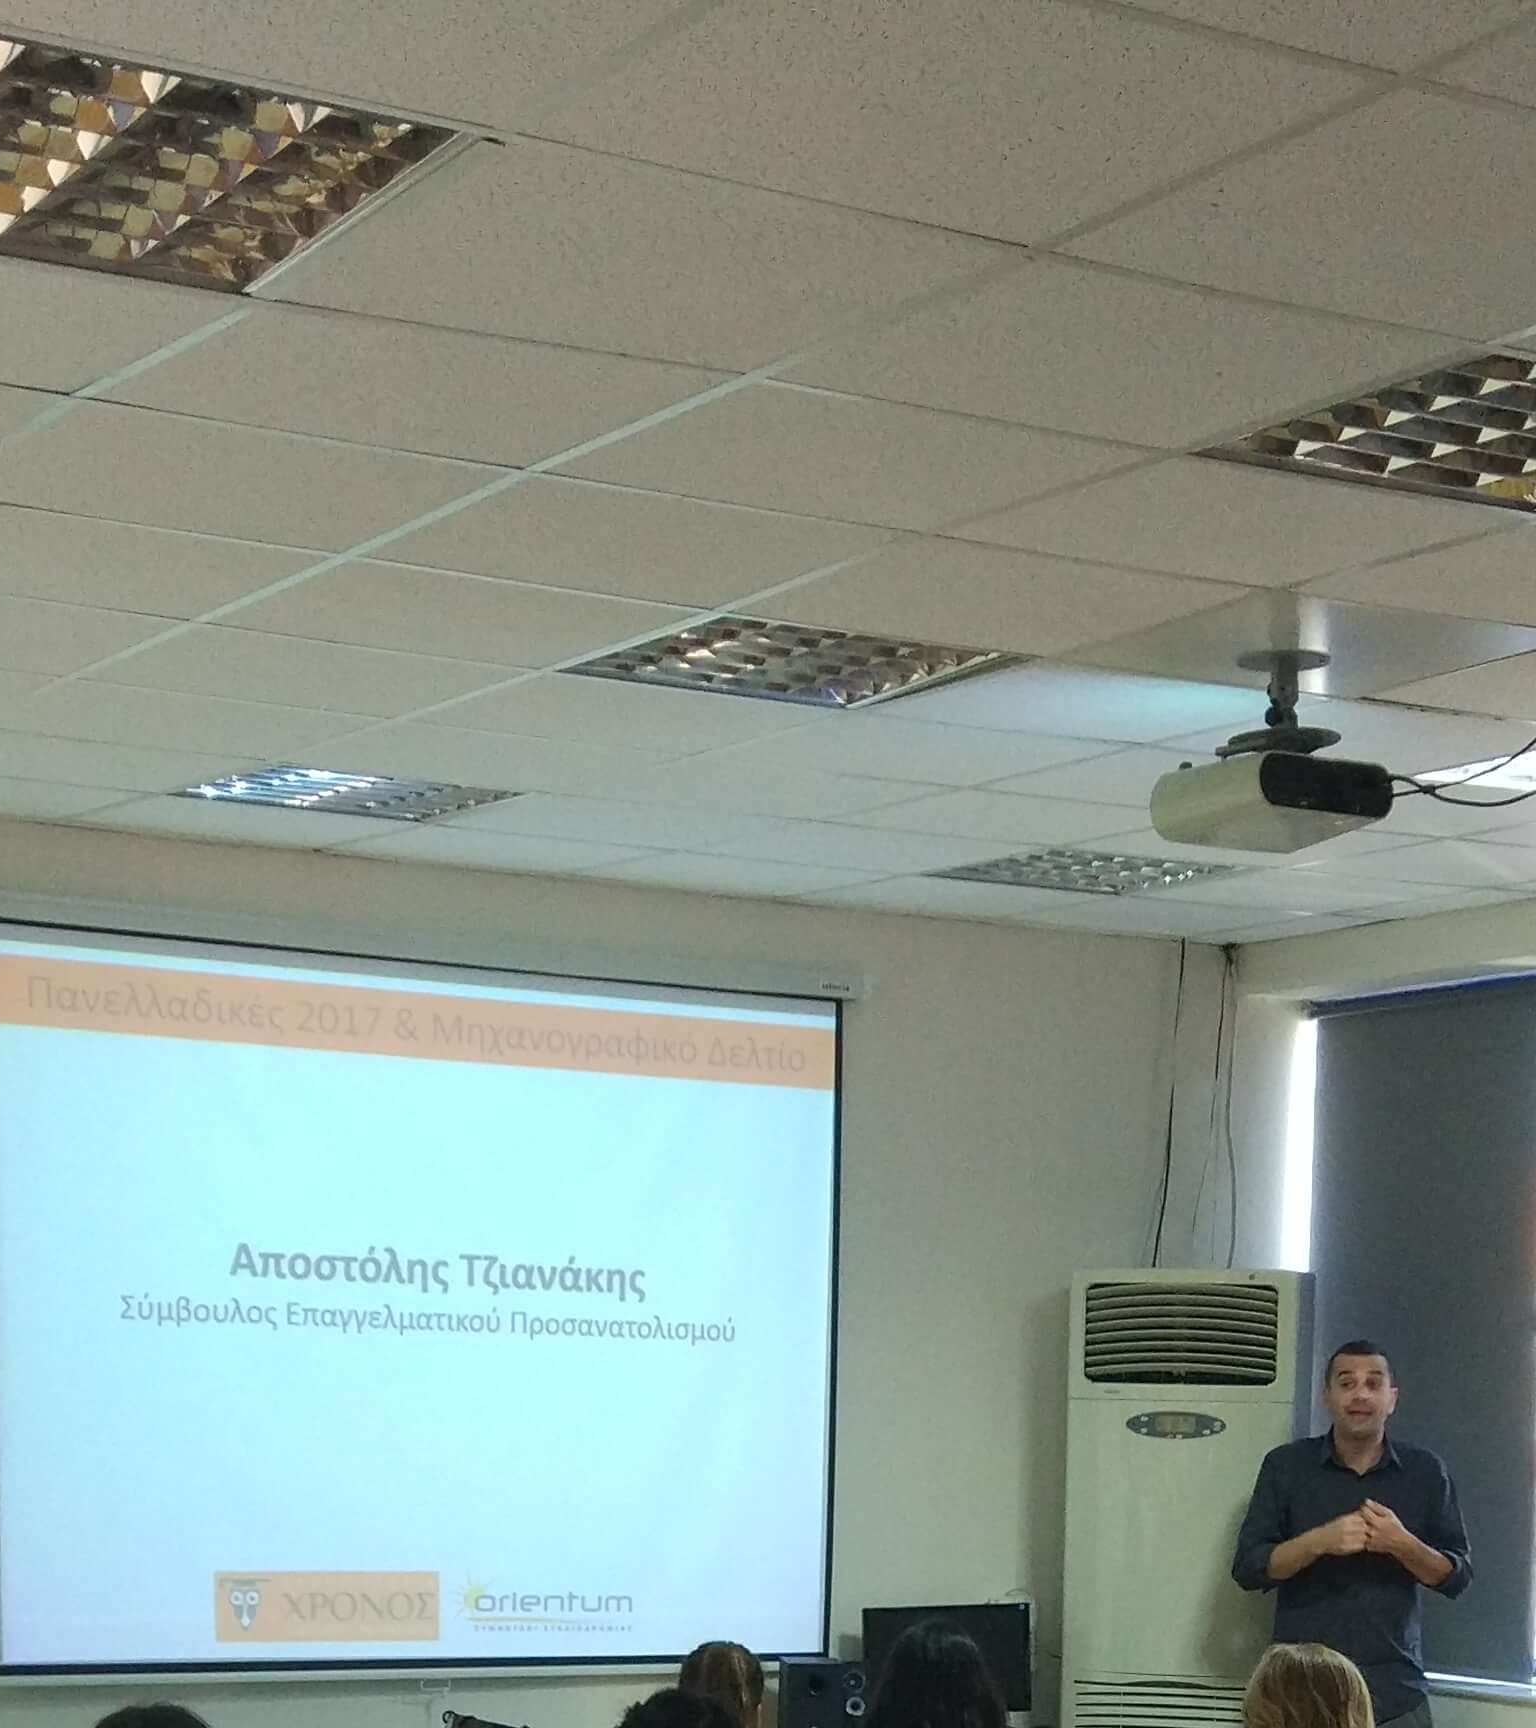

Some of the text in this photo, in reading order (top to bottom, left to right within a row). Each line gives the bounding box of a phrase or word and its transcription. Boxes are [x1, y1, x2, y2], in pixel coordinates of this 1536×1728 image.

[25, 975, 806, 1072] Πανελλαδικές 2017 & Μηχανογραφικό Δελτίο
[229, 1242, 646, 1303] Αποστόλης Τζιανάκης
[119, 1292, 736, 1346] Σύμβουλος Επαγγελματικού Προσανατολισμού
[280, 1591, 436, 1622] ΧΡΟΝΟΣ
[473, 1591, 633, 1613] orientum
